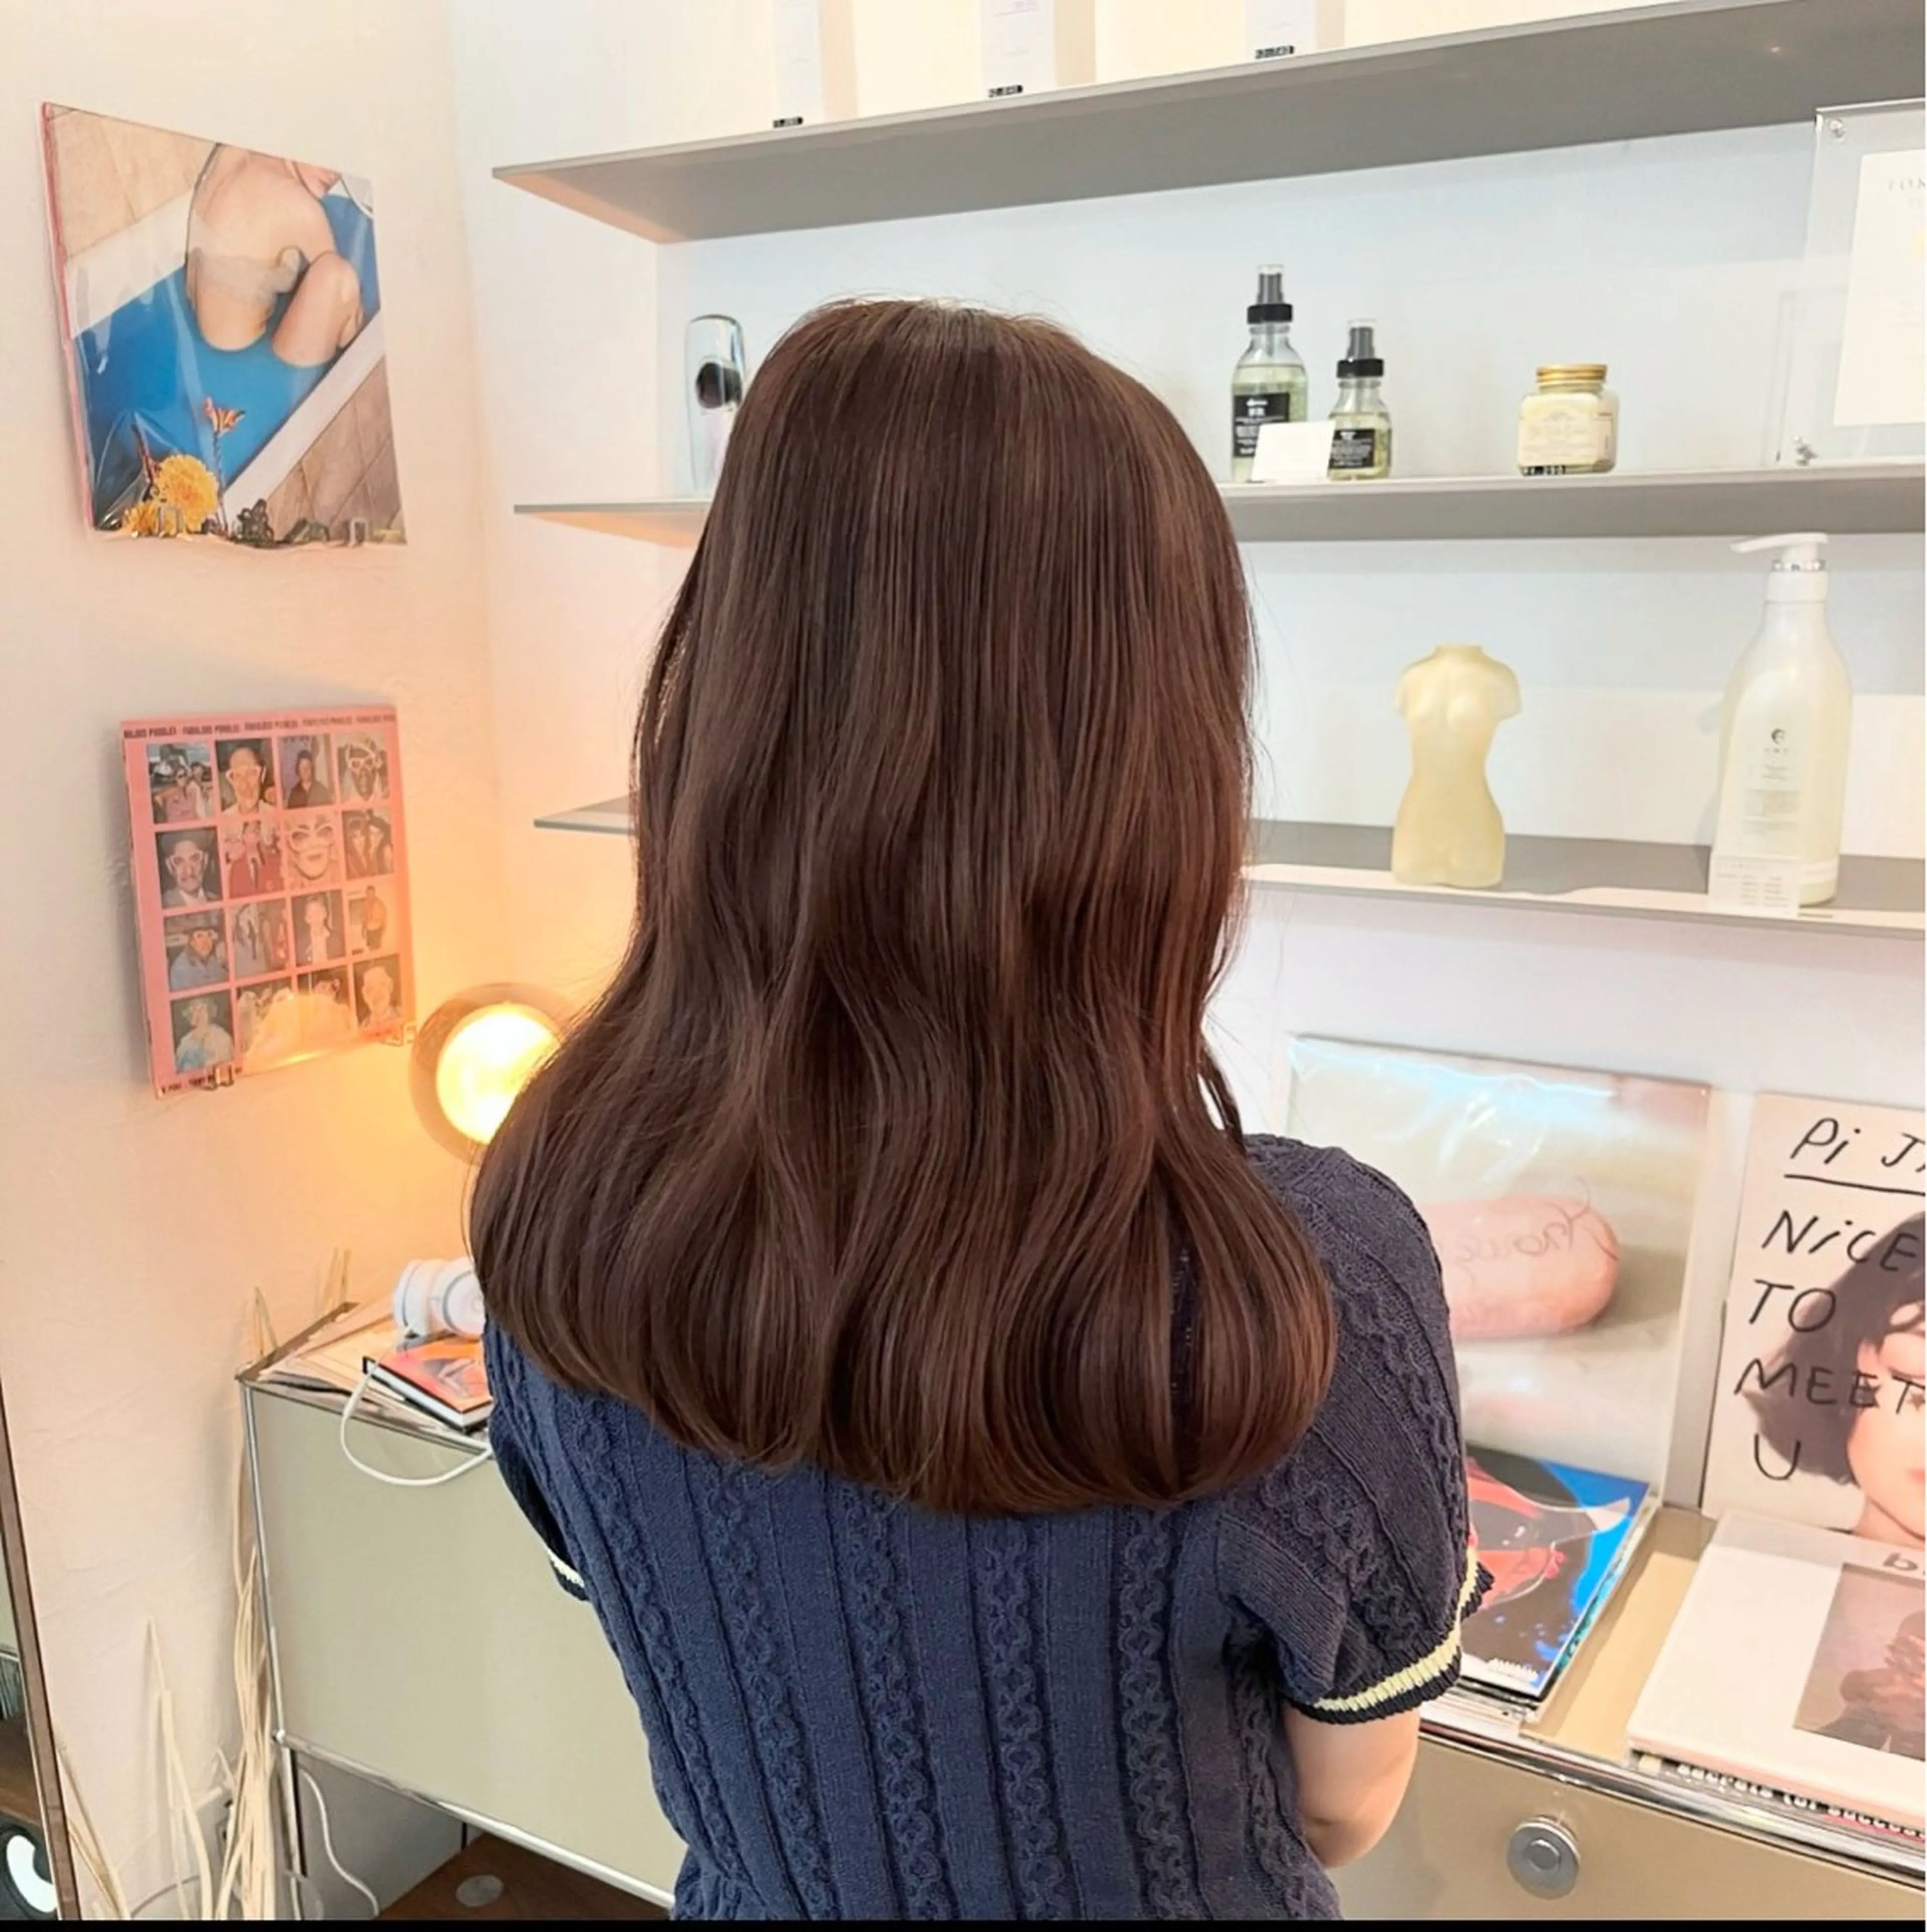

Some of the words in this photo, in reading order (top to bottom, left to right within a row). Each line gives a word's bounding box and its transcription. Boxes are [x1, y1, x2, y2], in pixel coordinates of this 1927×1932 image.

[1790, 1117, 1861, 1165] Pi
[1881, 1133, 1925, 1173] J
[1748, 1279, 1836, 1333] TO
[1734, 1357, 1925, 1415] MEET
[1754, 1433, 1802, 1481] U
